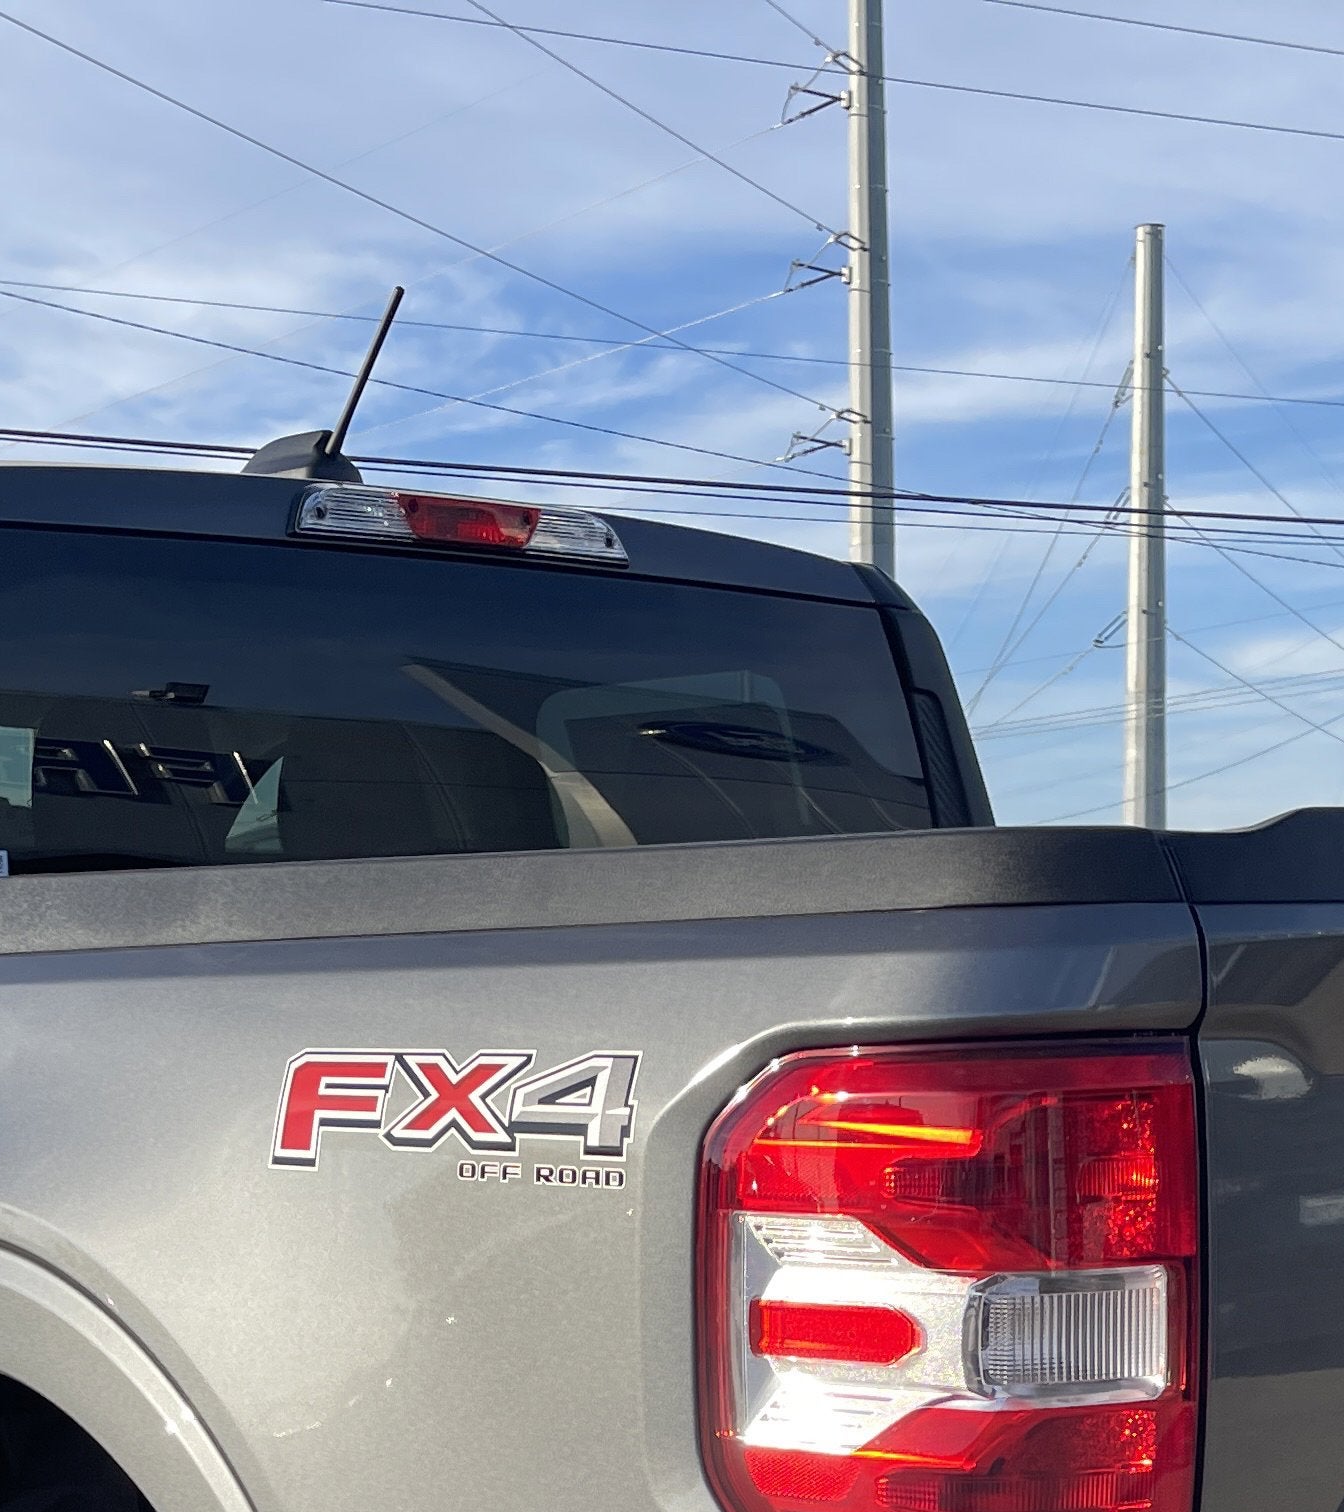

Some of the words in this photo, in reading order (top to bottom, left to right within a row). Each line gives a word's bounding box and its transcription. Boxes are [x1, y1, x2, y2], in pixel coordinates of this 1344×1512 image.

[268, 1048, 643, 1171] FX4
[456, 1161, 522, 1183] OFF
[533, 1165, 627, 1189] ROAD
